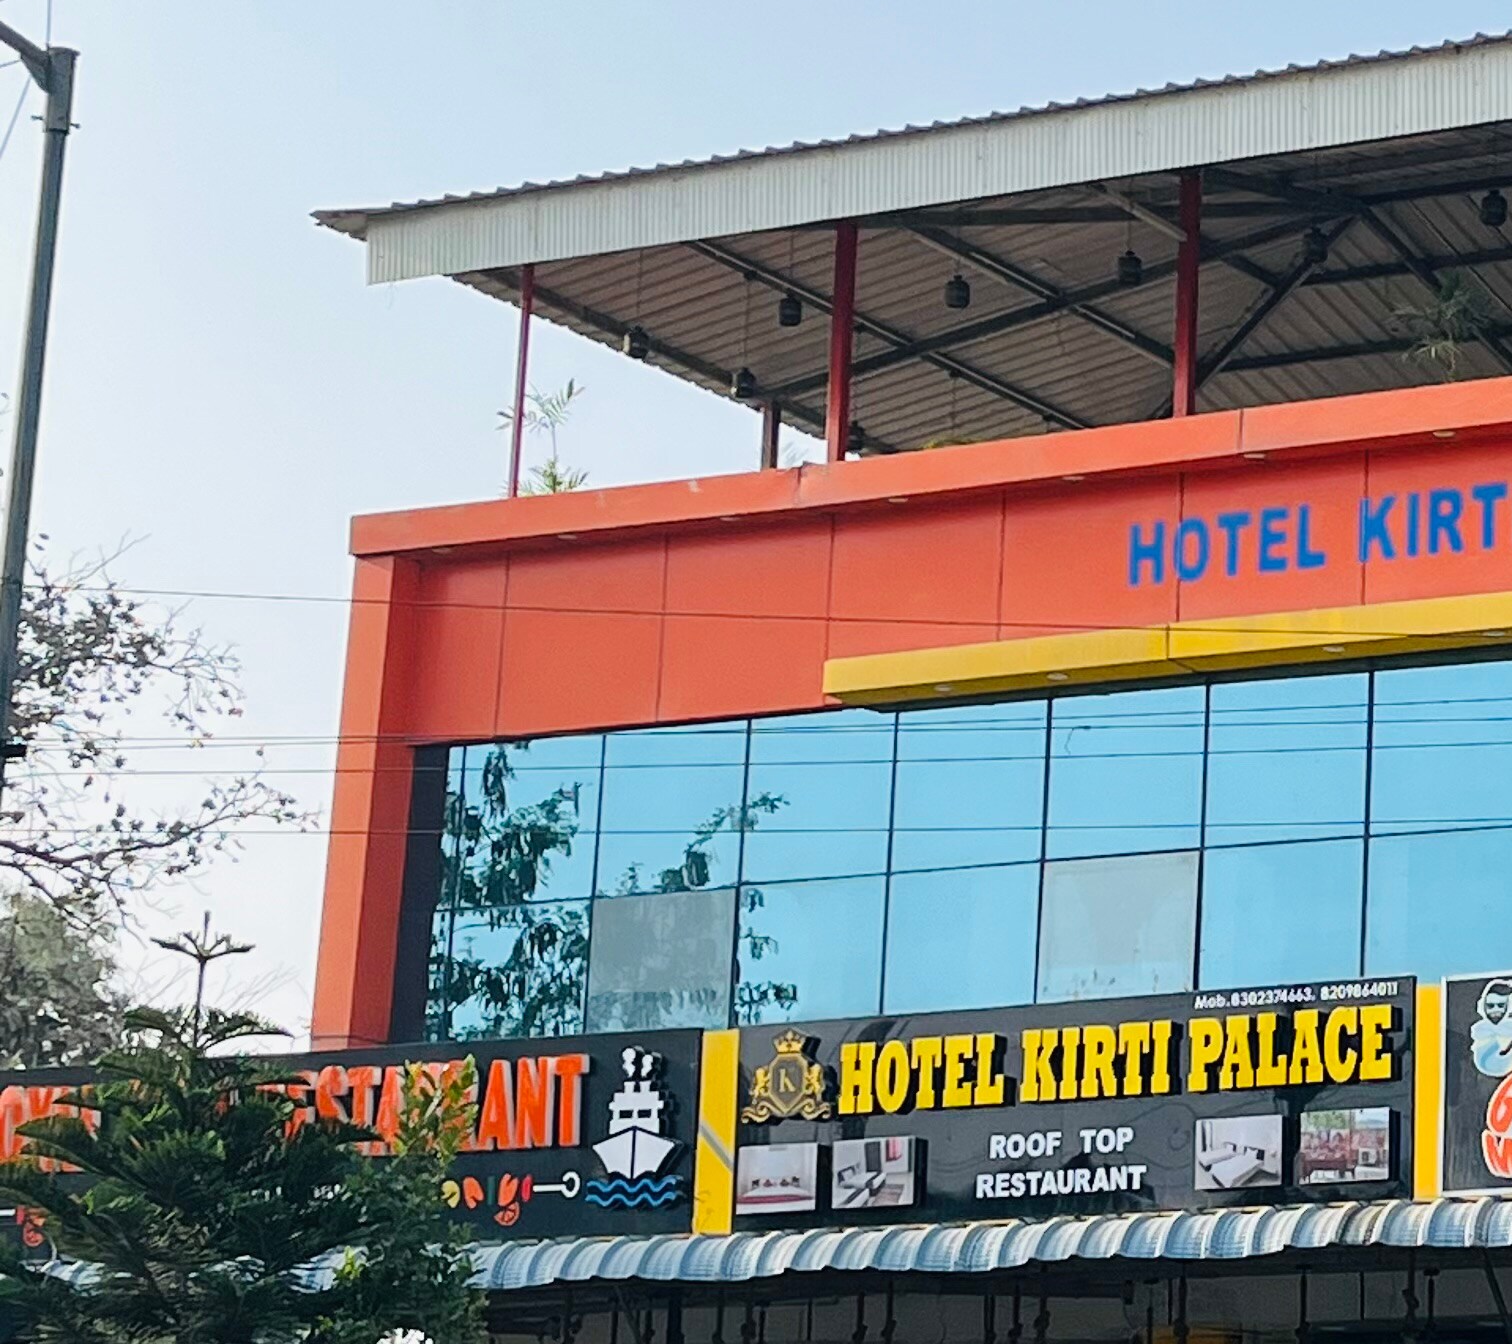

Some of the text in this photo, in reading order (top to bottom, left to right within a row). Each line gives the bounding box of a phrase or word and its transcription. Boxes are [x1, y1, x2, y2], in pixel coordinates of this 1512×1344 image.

[1128, 504, 1326, 587] HOTEL
[837, 1004, 1393, 1115] HOTEL KIRTI PALACE
[255, 1054, 590, 1157] ESTAANT
[989, 1127, 1135, 1159] ROOF TOP
[975, 1165, 1147, 1199] RESTAURANT
